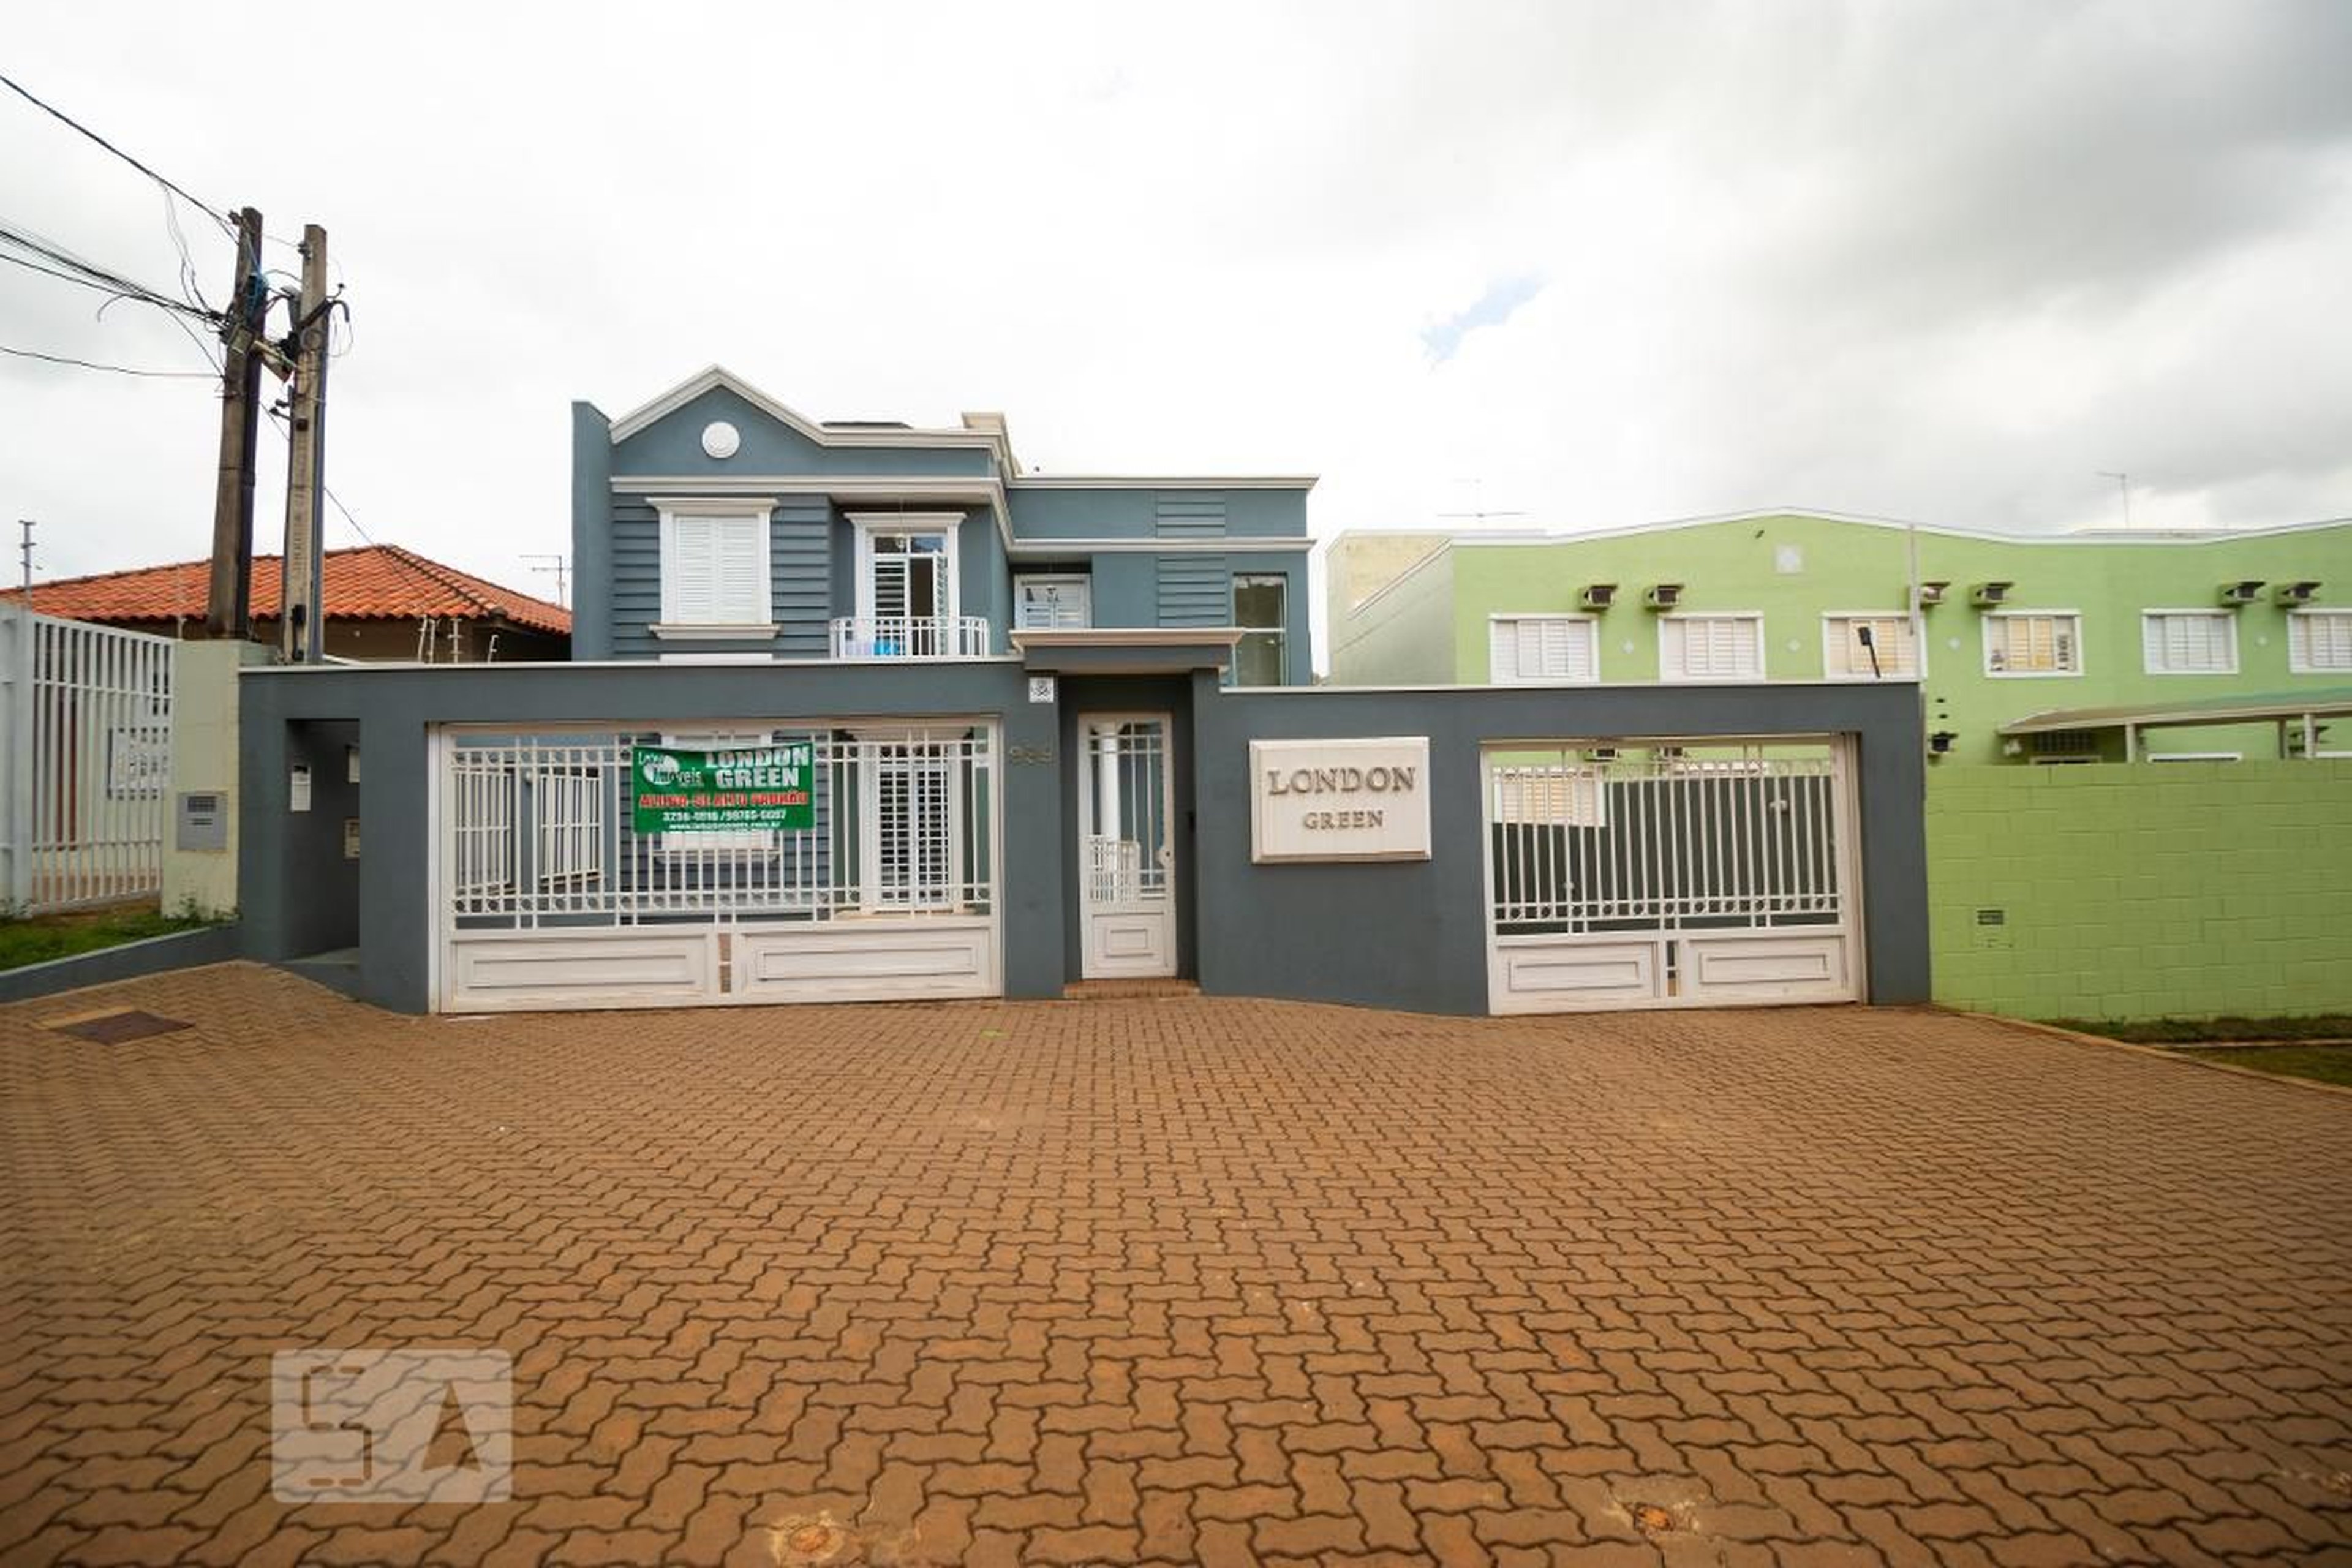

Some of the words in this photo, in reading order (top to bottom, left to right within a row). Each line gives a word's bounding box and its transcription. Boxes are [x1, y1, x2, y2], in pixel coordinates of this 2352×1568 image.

[705, 747, 809, 768] LONDON
[715, 767, 799, 788] GREEN
[1267, 767, 1416, 796] LONDON
[1303, 810, 1383, 830] GREEN
